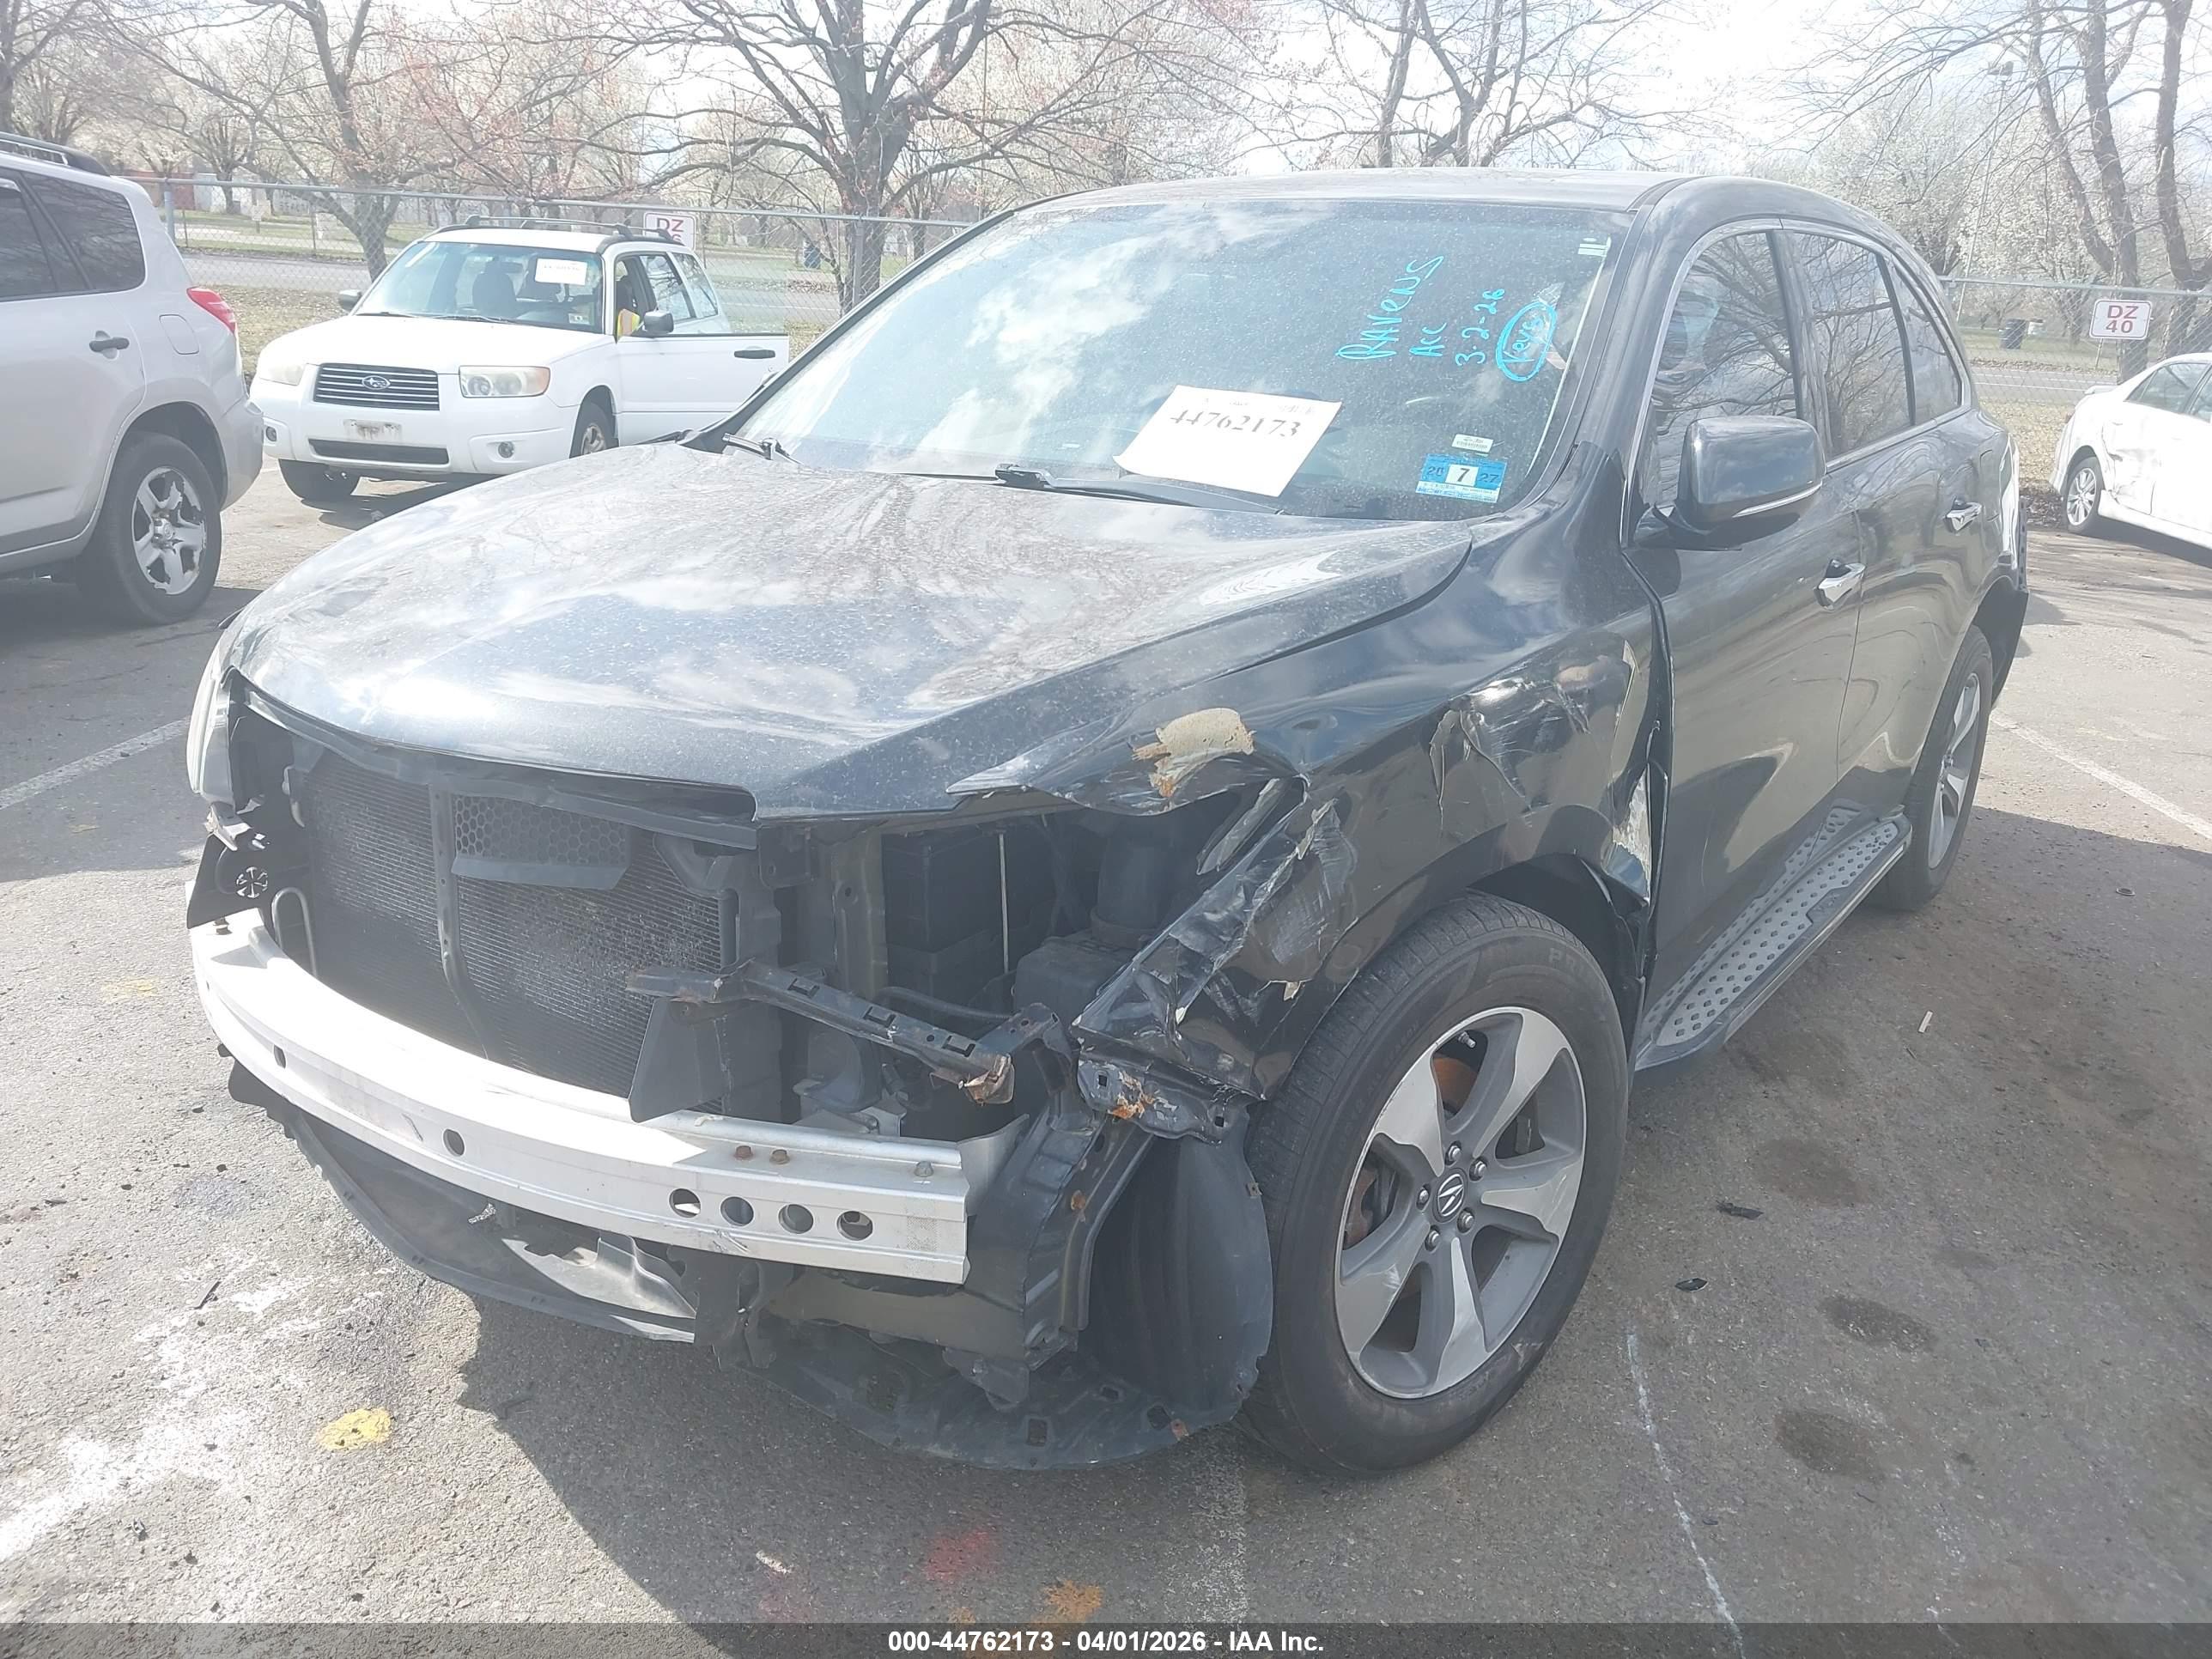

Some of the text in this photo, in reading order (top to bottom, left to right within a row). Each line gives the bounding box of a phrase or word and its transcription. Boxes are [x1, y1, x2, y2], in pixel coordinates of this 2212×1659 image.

[657, 217, 684, 232] DZ
[2107, 305, 2139, 319] DZ
[2106, 319, 2133, 333] 40
[1457, 467, 1470, 483] 7
[1479, 473, 1499, 483] 27
